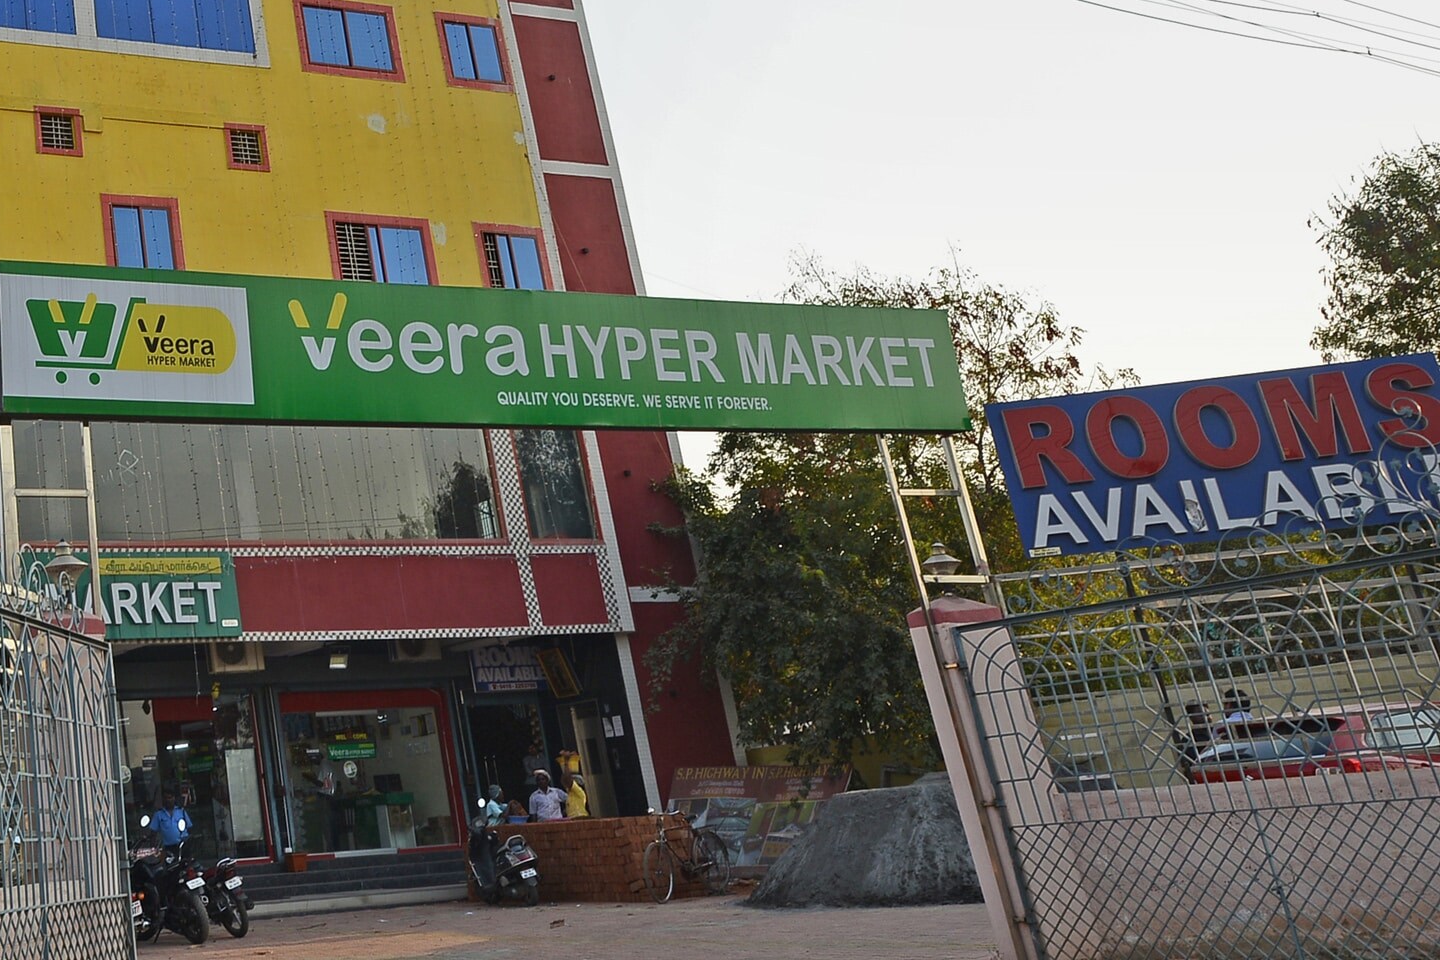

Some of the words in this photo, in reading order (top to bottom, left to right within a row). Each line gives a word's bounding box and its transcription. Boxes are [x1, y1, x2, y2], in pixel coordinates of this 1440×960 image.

[137, 315, 215, 355] Veera
[288, 292, 530, 376] Veera
[539, 324, 726, 383] HYPER
[735, 332, 935, 388] MARKET
[147, 355, 176, 366] HYPER
[179, 356, 216, 368] MARKET
[497, 391, 548, 406] QUALITY
[551, 392, 579, 406] YOU
[582, 393, 640, 408] DESERVE.
[642, 394, 662, 408] WE
[665, 395, 701, 409] SERVE
[704, 396, 716, 409] IT
[717, 397, 773, 410] FOREVER.
[1001, 363, 1440, 489] ROOMS
